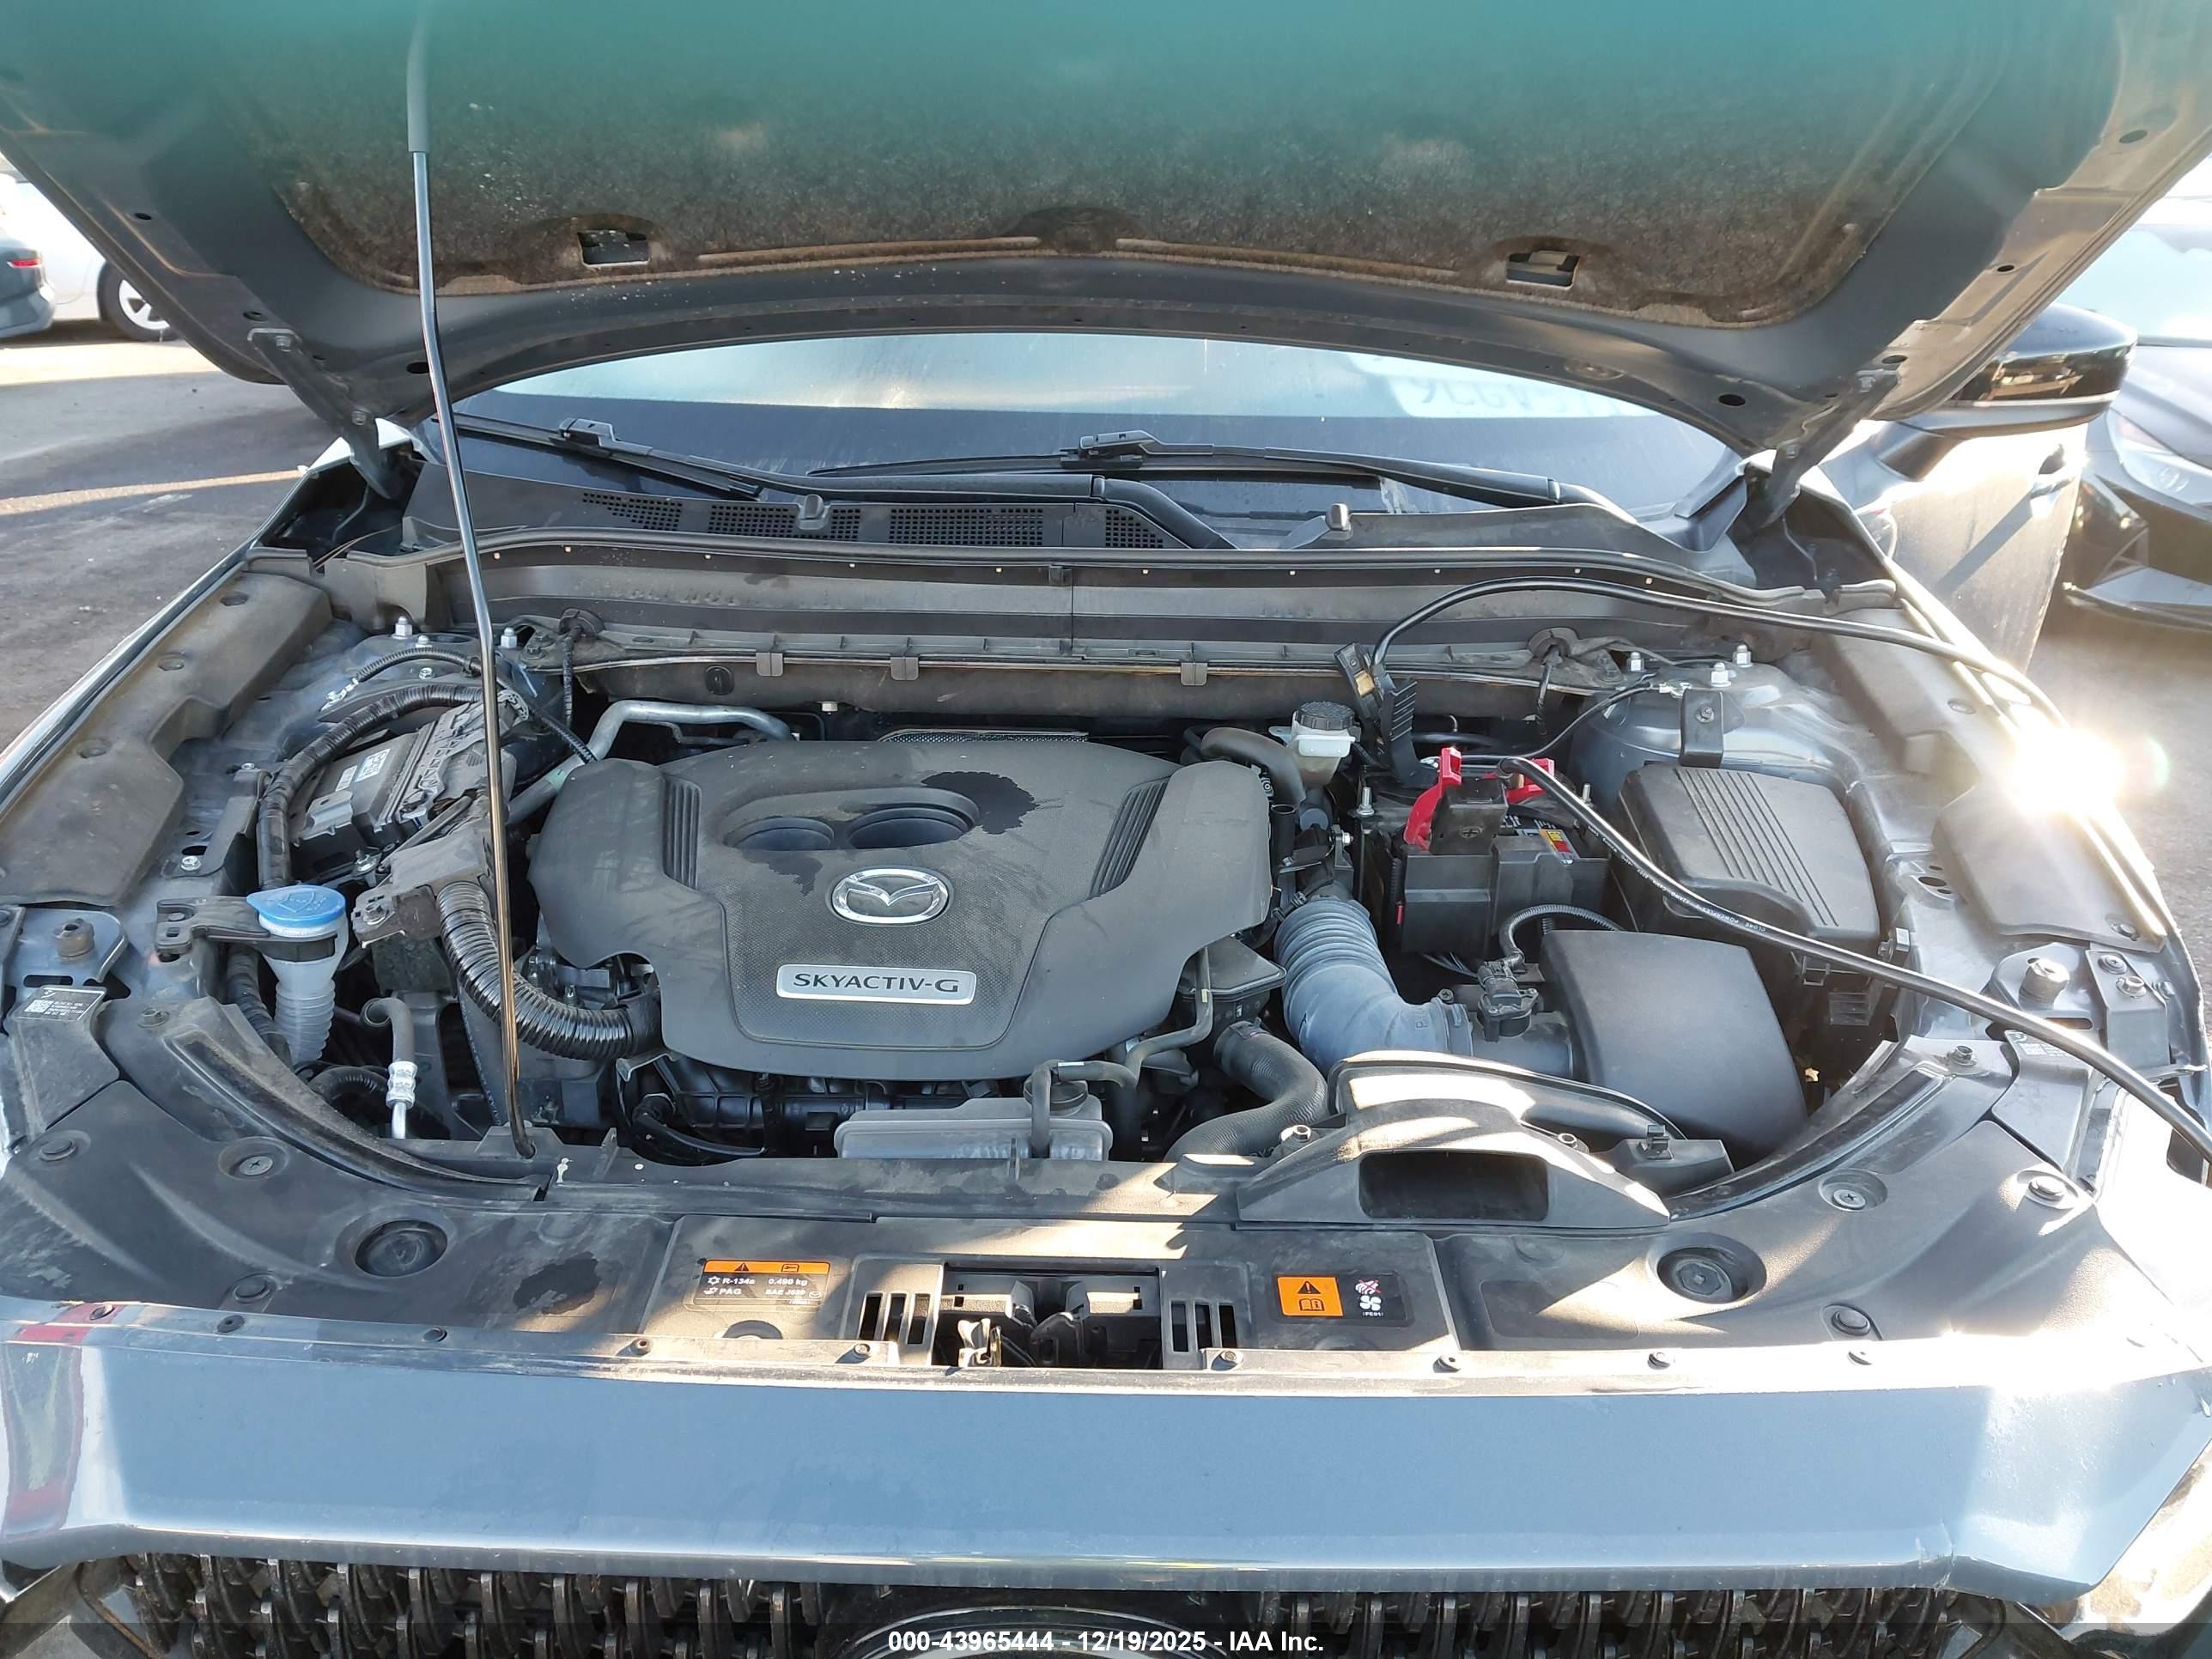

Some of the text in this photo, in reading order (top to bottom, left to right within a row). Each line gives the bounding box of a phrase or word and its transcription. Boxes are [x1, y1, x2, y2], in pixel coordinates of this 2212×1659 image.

[793, 973, 959, 993] SKYACTIV-G
[795, 1278, 809, 1287] kg
[718, 1287, 743, 1296] PAG
